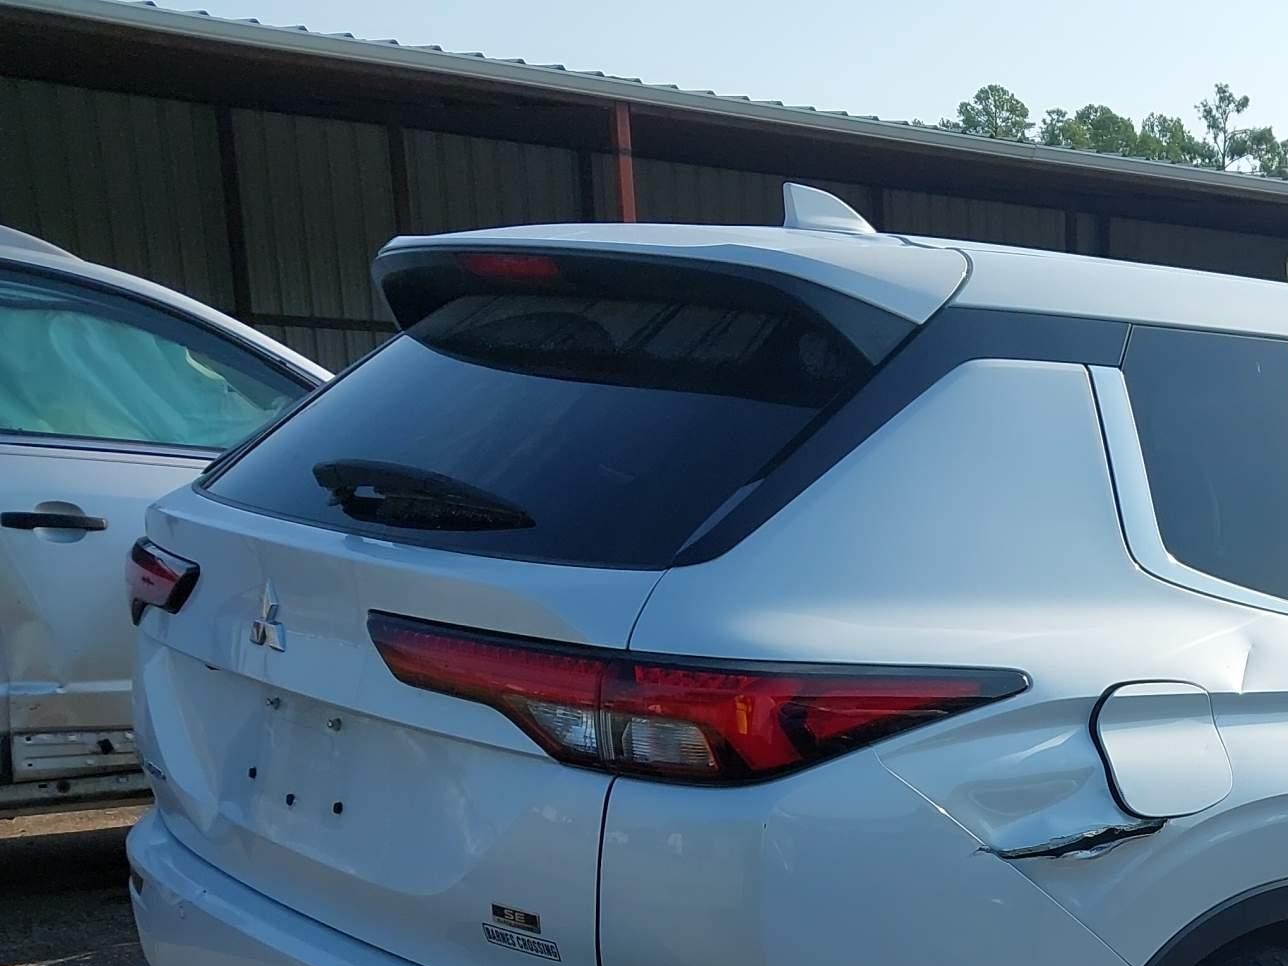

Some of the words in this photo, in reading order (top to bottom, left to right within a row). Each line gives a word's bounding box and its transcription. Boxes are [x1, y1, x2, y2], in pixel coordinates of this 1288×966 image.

[503, 909, 527, 922] SE
[484, 926, 517, 947] BARNES
[517, 936, 558, 957] CROSSING
